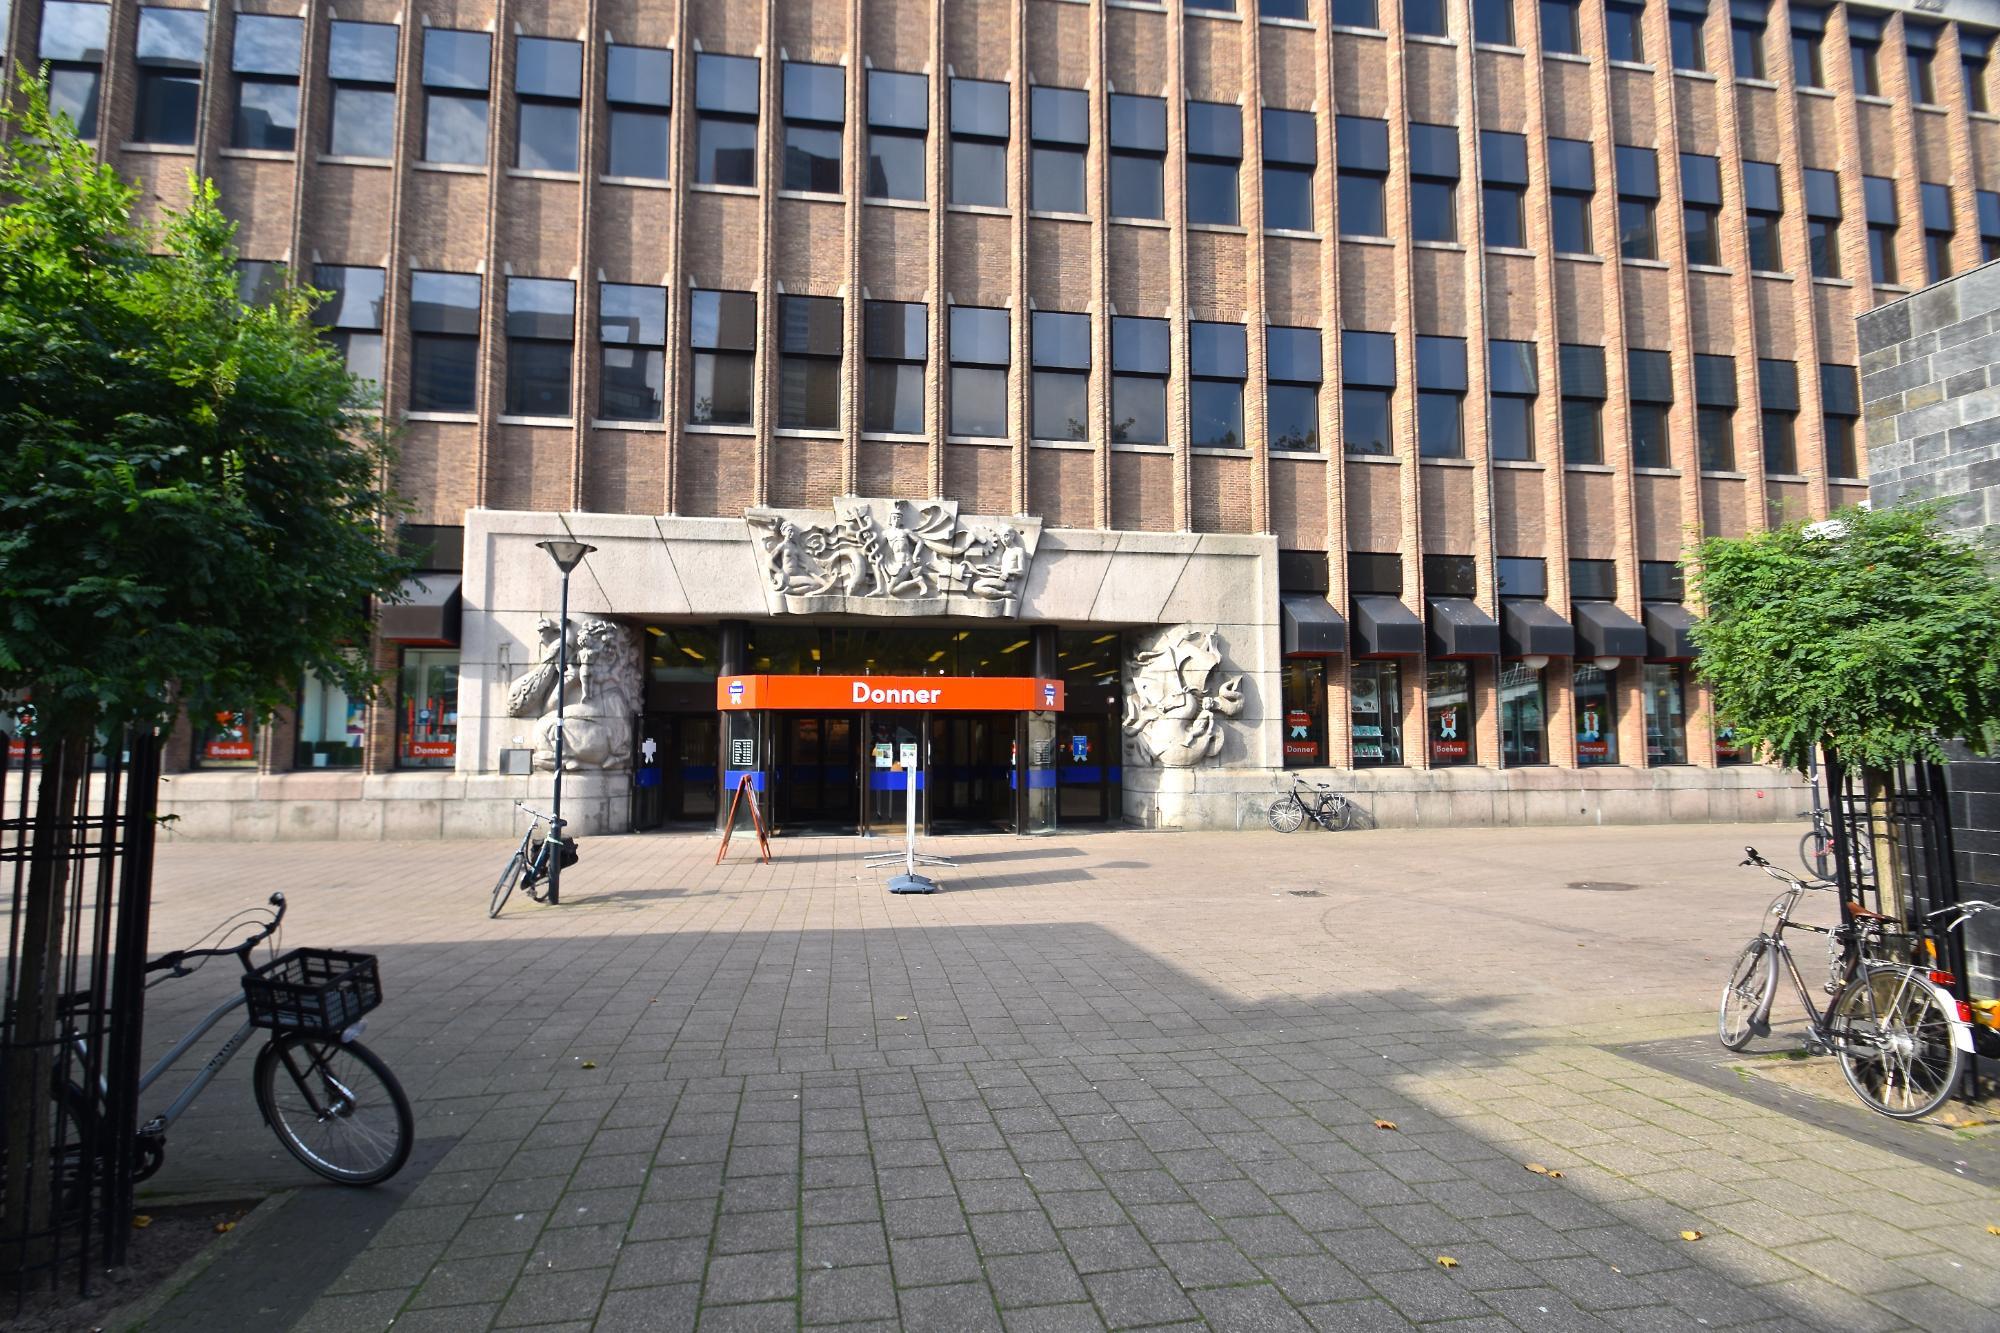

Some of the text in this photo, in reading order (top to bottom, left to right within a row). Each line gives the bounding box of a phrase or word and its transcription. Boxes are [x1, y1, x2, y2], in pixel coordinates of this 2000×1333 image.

[852, 681, 942, 704] Donner
[211, 745, 249, 755] Boeken
[414, 745, 449, 755] Donner
[1286, 745, 1315, 753] Donner
[1436, 744, 1463, 753] Boeken
[1580, 745, 1605, 753] Donner
